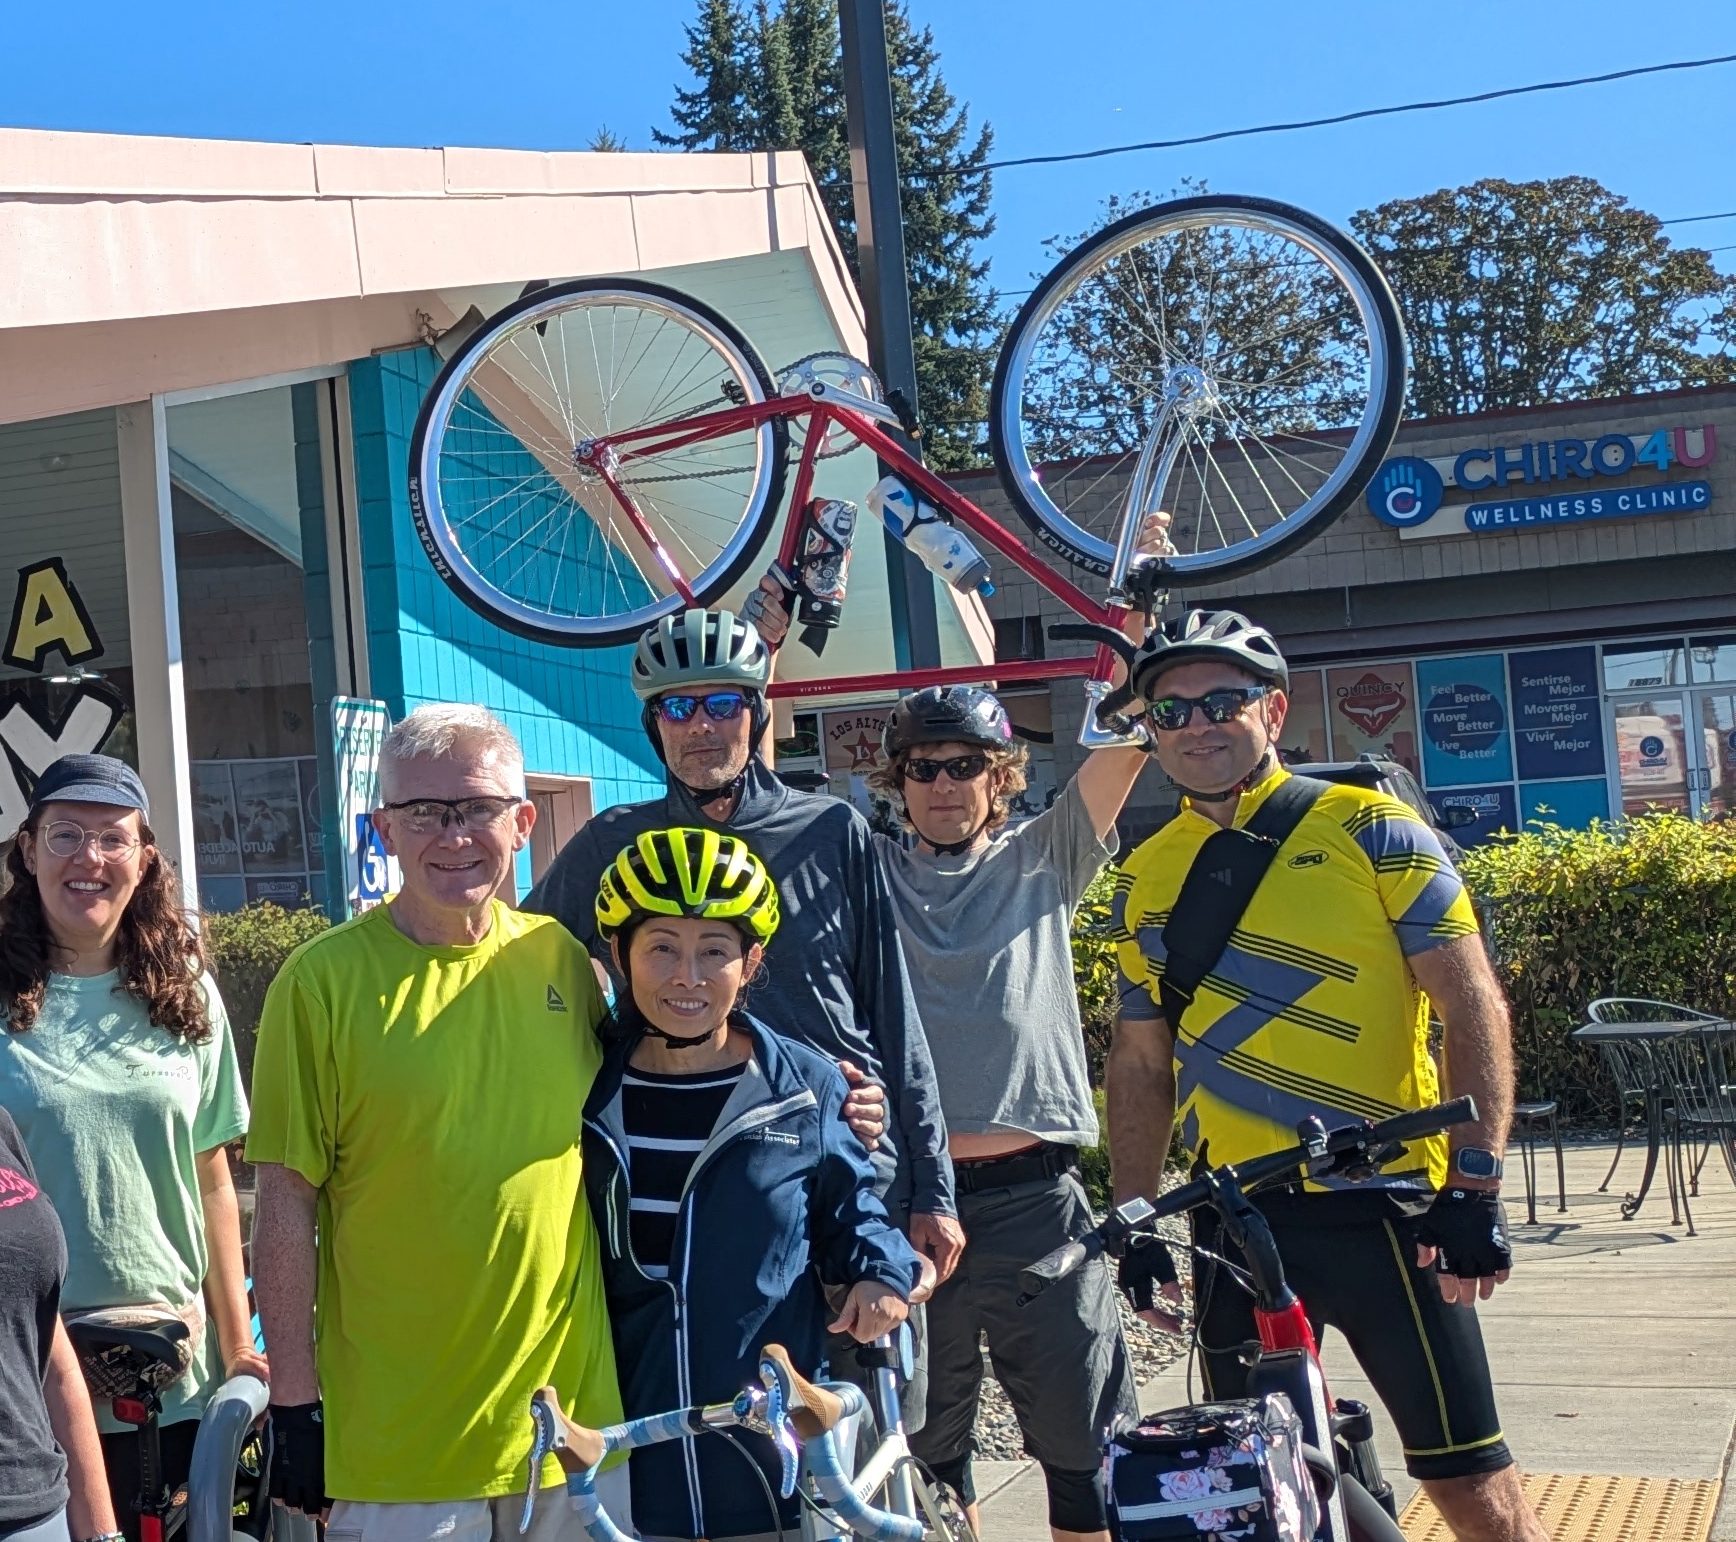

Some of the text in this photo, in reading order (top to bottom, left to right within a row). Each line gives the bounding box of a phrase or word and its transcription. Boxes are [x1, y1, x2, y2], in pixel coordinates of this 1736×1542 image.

[1454, 424, 1716, 491] CHIRO4U
[1472, 487, 1706, 526] WELLNESS CLINIC
[4, 558, 102, 668] A
[1521, 675, 1571, 687] Sentirse
[1336, 681, 1405, 698] QUINCY
[1431, 684, 1455, 695] Feel
[1549, 684, 1586, 696] Mejor
[1455, 693, 1492, 703] Better
[1525, 703, 1576, 715] Moverse
[1433, 712, 1467, 722] Move
[1552, 712, 1588, 724] Mejor
[830, 717, 886, 741] LOS ALTO
[1457, 721, 1494, 731] Better
[1526, 731, 1555, 742] Vivir
[1435, 740, 1460, 751] Live
[1554, 739, 1590, 752] Mejor
[1459, 749, 1496, 759] Better
